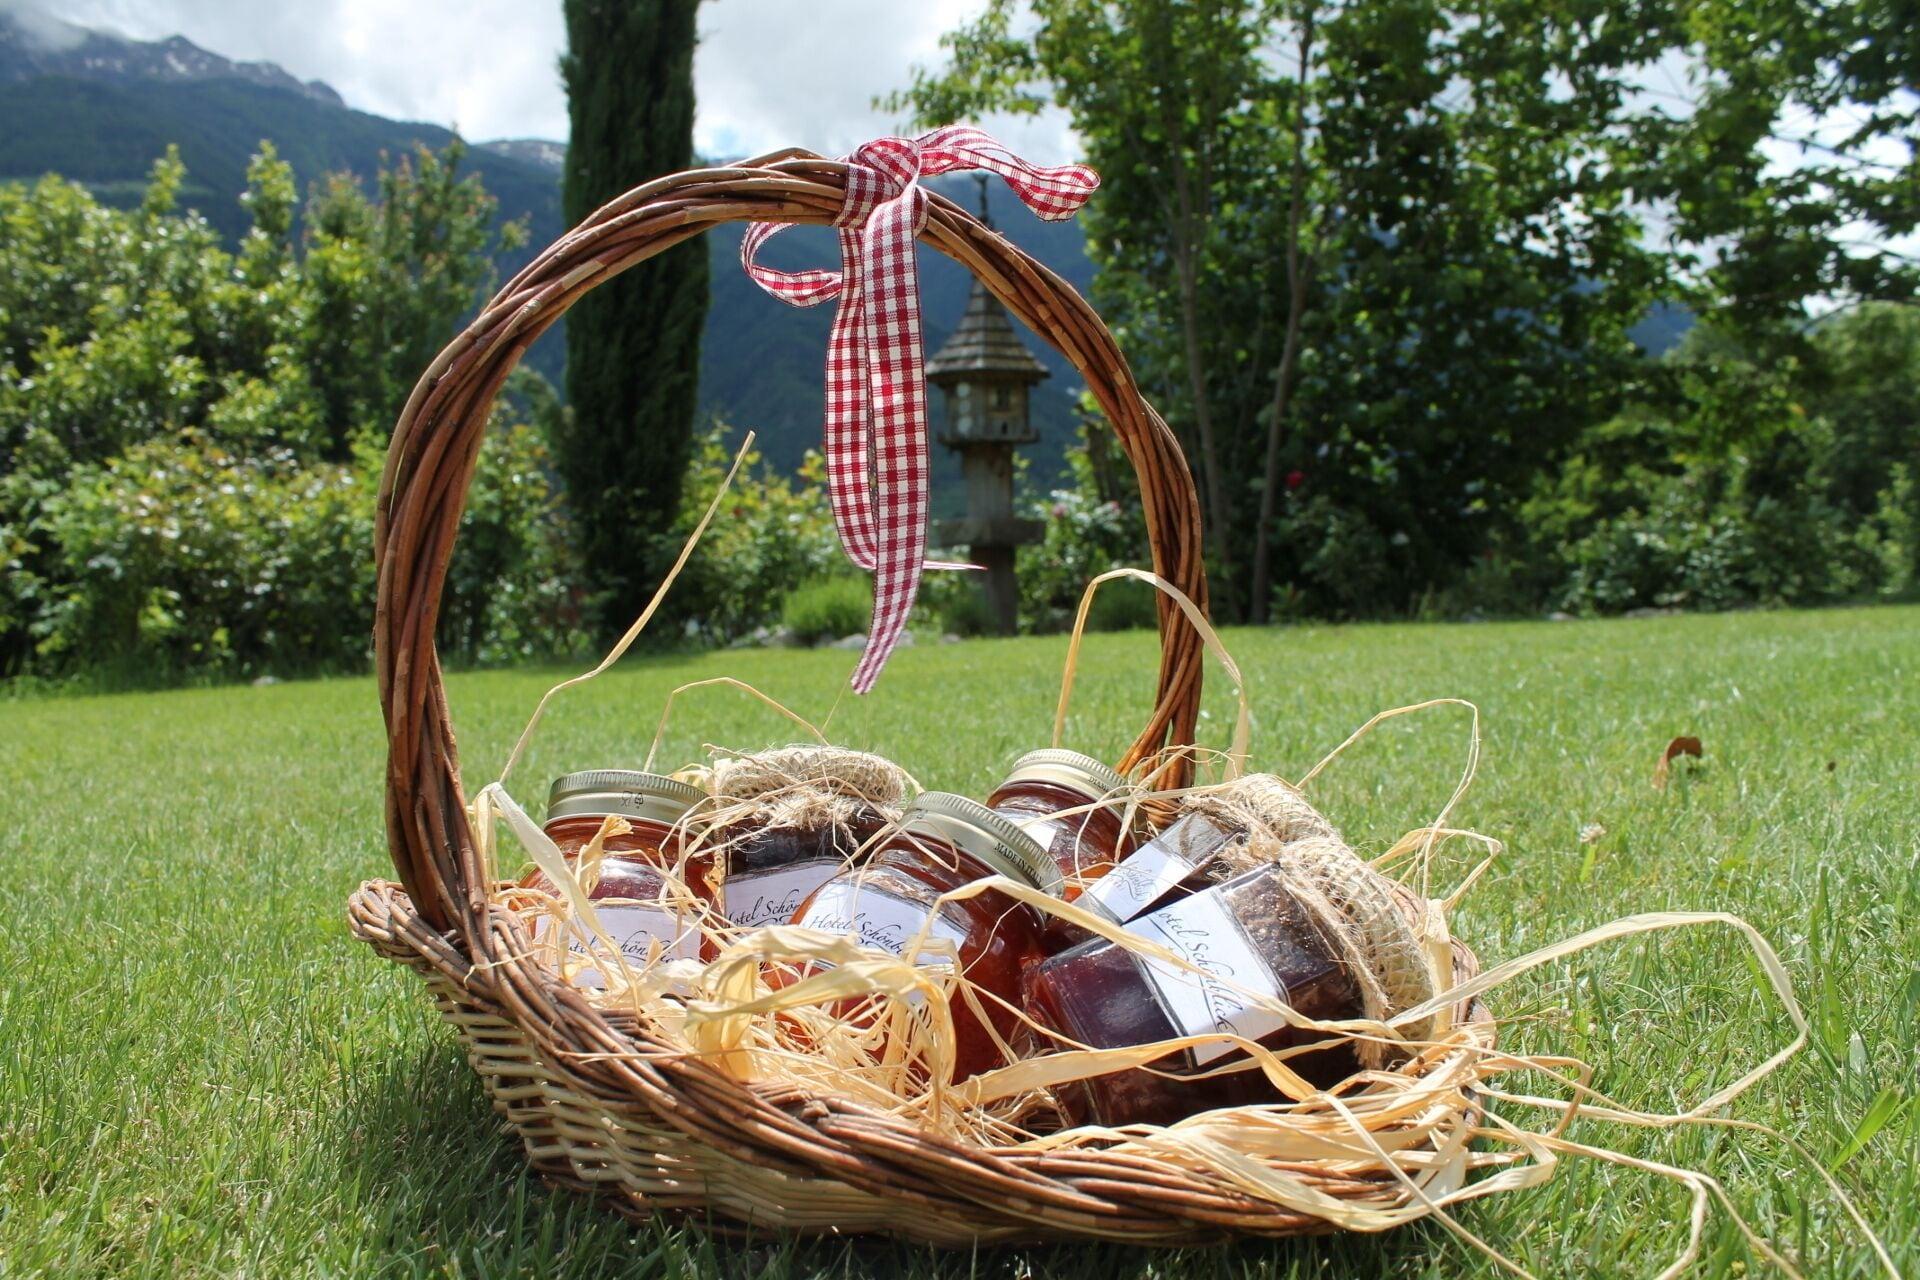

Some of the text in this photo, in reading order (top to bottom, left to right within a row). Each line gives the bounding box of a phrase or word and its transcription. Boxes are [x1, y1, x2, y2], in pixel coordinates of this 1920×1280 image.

[994, 842, 1018, 864] MADE
[1026, 865, 1042, 885] ITALY
[809, 912, 904, 954] Hotel Schönb
